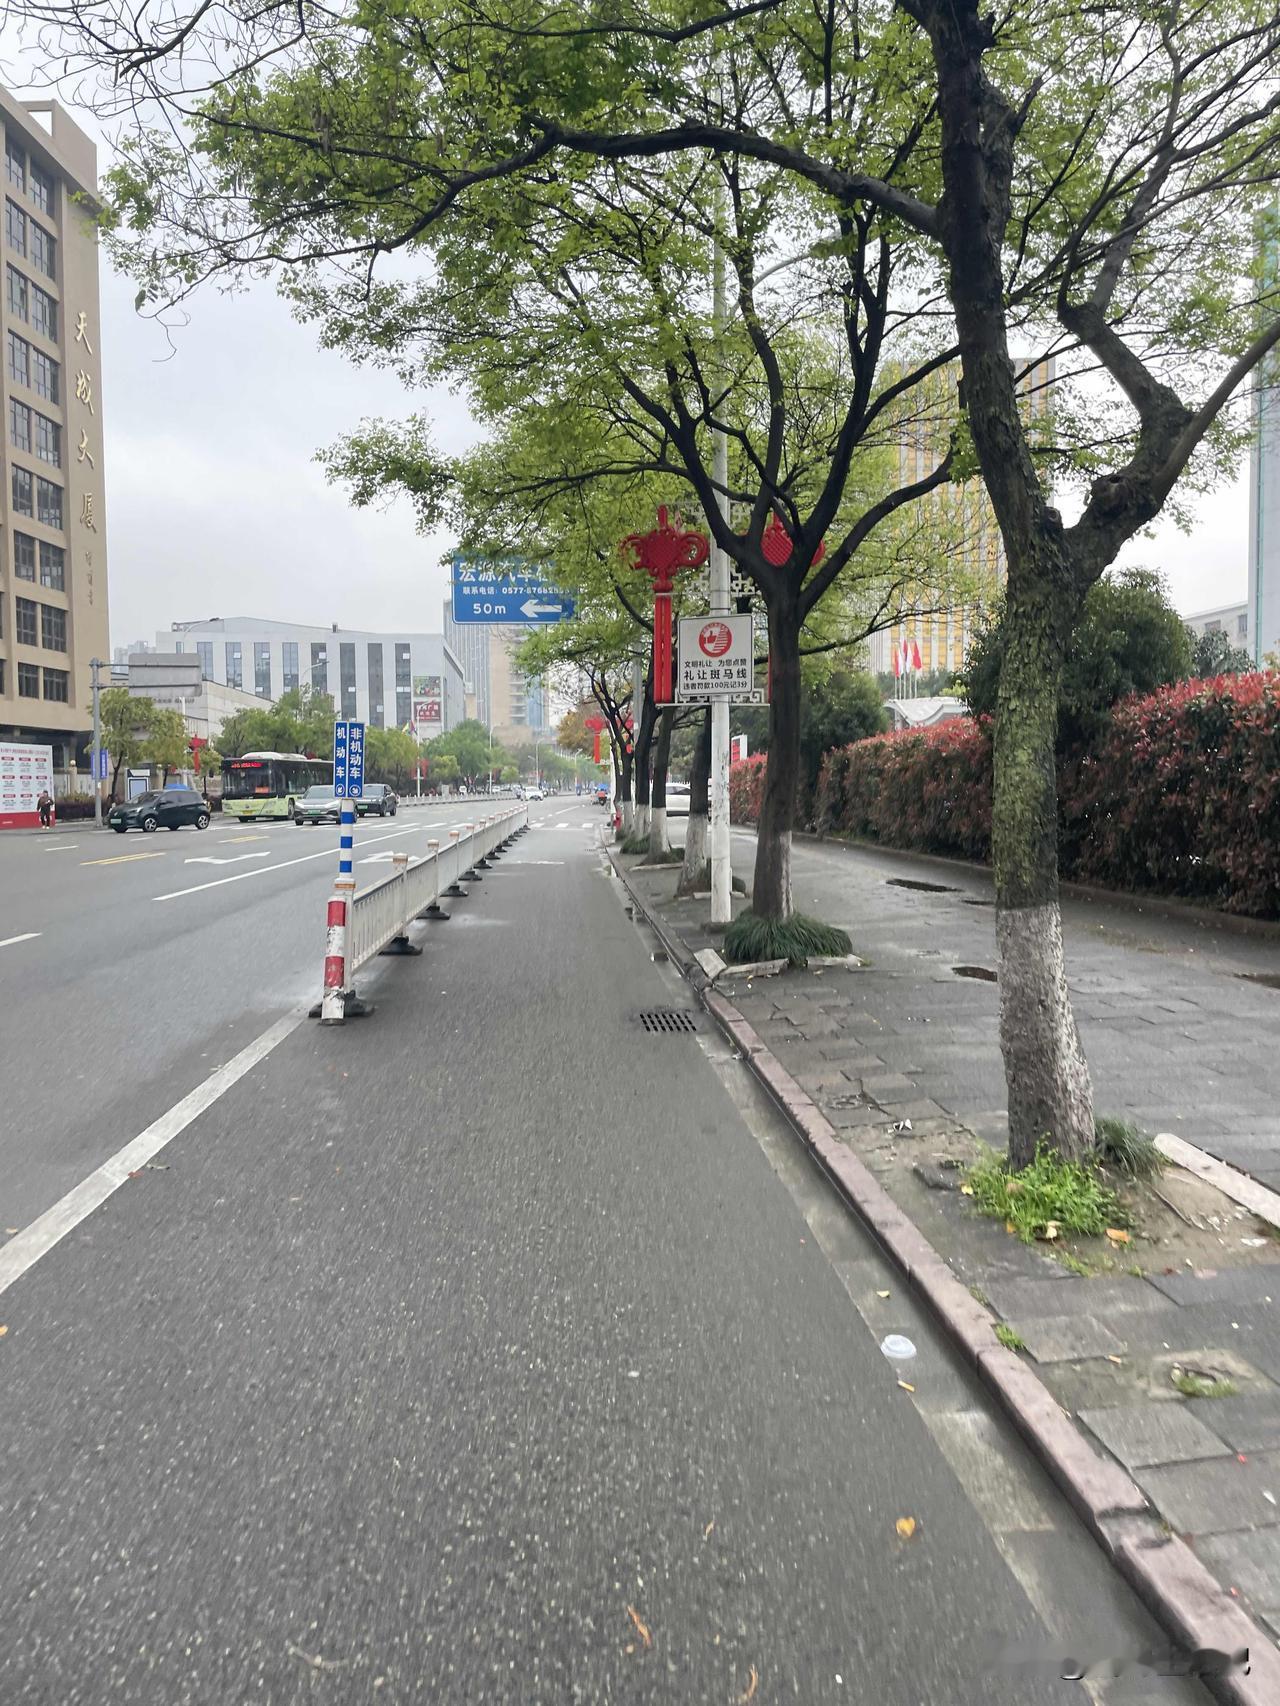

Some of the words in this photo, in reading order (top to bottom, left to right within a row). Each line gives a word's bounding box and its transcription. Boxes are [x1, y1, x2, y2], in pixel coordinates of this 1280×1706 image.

[459, 560, 549, 582] 宏源汽车
[473, 603, 506, 614] 50m
[684, 668, 747, 680] 礼让斑马线
[336, 728, 345, 778] 机动车
[350, 728, 362, 779] 非机动车
